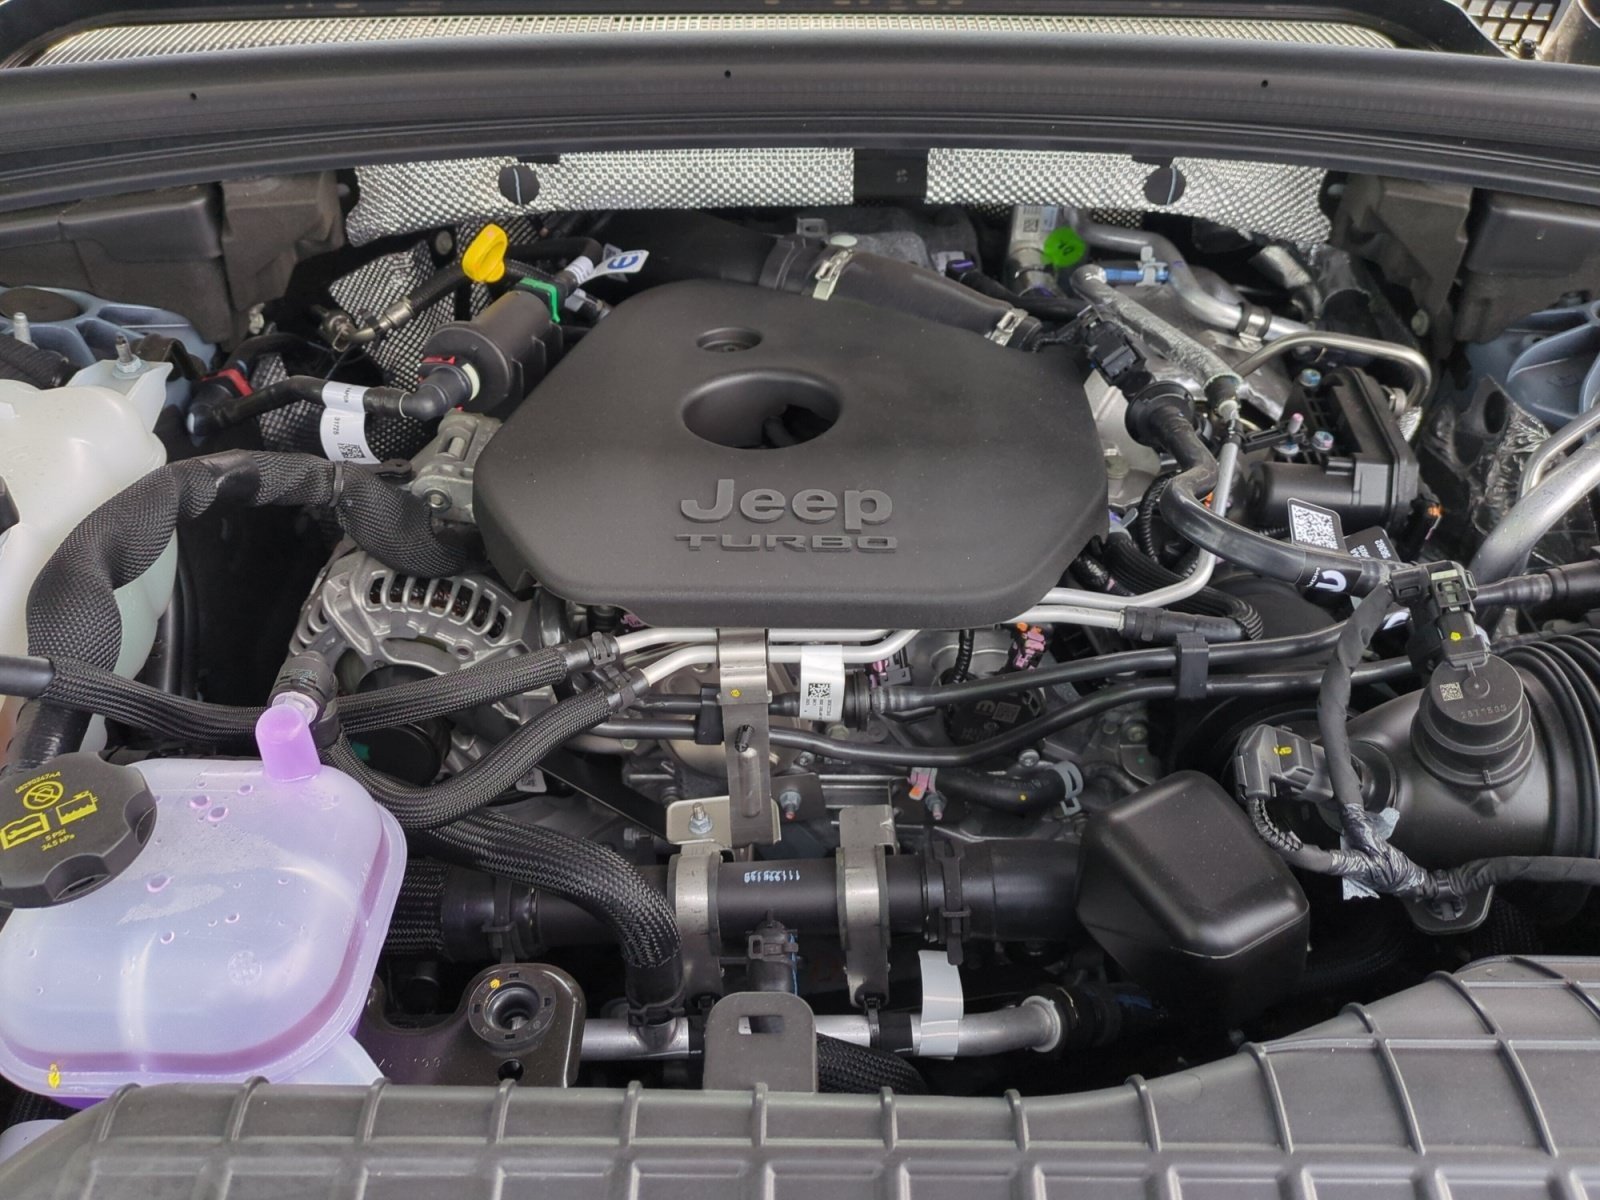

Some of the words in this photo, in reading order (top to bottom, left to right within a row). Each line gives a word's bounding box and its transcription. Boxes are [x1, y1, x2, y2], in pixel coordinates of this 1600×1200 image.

[680, 478, 893, 534] Jeep
[675, 534, 899, 552] TURBO
[52, 828, 66, 838] PSI
